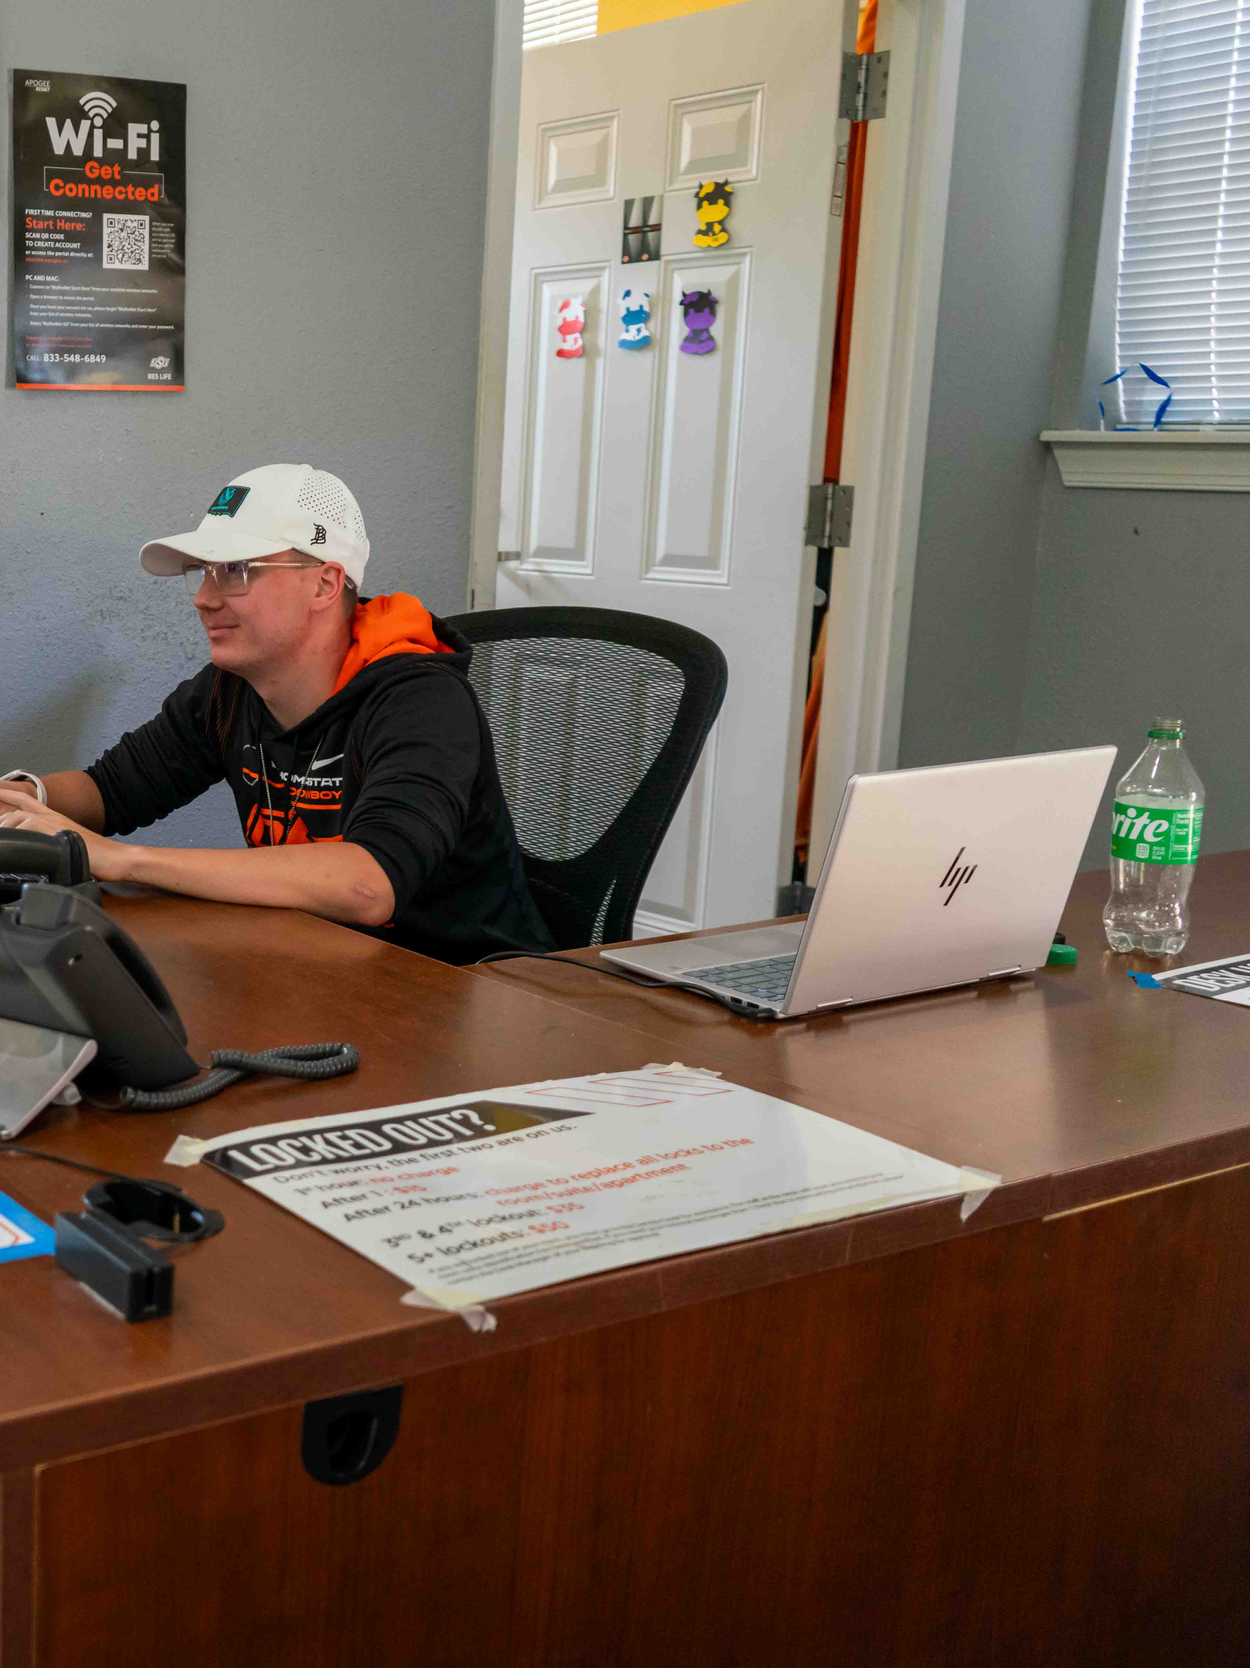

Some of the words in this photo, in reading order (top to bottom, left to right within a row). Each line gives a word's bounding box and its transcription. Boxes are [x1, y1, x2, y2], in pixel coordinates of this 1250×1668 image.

[45, 115, 160, 161] Wi-Fi
[84, 160, 121, 180] Get
[49, 178, 159, 201] Connected
[25, 208, 41, 216] FIRST
[41, 209, 55, 217] TIME
[55, 210, 93, 218] CONNECTING?
[25, 217, 54, 229] Start
[56, 219, 86, 231] Here:
[34, 240, 55, 248] CREATE
[43, 353, 106, 363] 833-548-6849
[147, 372, 159, 380] RES
[1112, 807, 1169, 842] rite
[1172, 969, 1247, 992] DESK
[228, 1128, 393, 1172] LOCKED
[381, 1108, 497, 1146] OUT?
[273, 1166, 327, 1184] Don't
[329, 1162, 390, 1177] worry,
[386, 1153, 420, 1167] the
[420, 1147, 460, 1161] first
[458, 1141, 494, 1154] two
[496, 1134, 525, 1147] are
[525, 1128, 549, 1140] on
[550, 1124, 578, 1134] us.
[342, 1206, 393, 1222] After
[397, 1198, 422, 1211] 24
[420, 1190, 485, 1204] hours:
[484, 1180, 552, 1197] charge
[546, 1175, 569, 1186] to
[569, 1160, 636, 1183] replace
[635, 1154, 660, 1167] all
[655, 1145, 705, 1161] locks
[701, 1142, 724, 1152] to
[721, 1135, 755, 1148] the
[368, 1176, 395, 1184] no
[398, 1165, 461, 1181] charge
[495, 1162, 692, 1207] room/suite/apartment
[320, 1192, 369, 1210] After
[392, 1184, 428, 1194] $15
[416, 1229, 436, 1240] &
[545, 1201, 585, 1214] $35
[406, 1251, 435, 1264] 5+
[435, 1230, 530, 1257] lockouts:
[527, 1220, 570, 1234] $50
